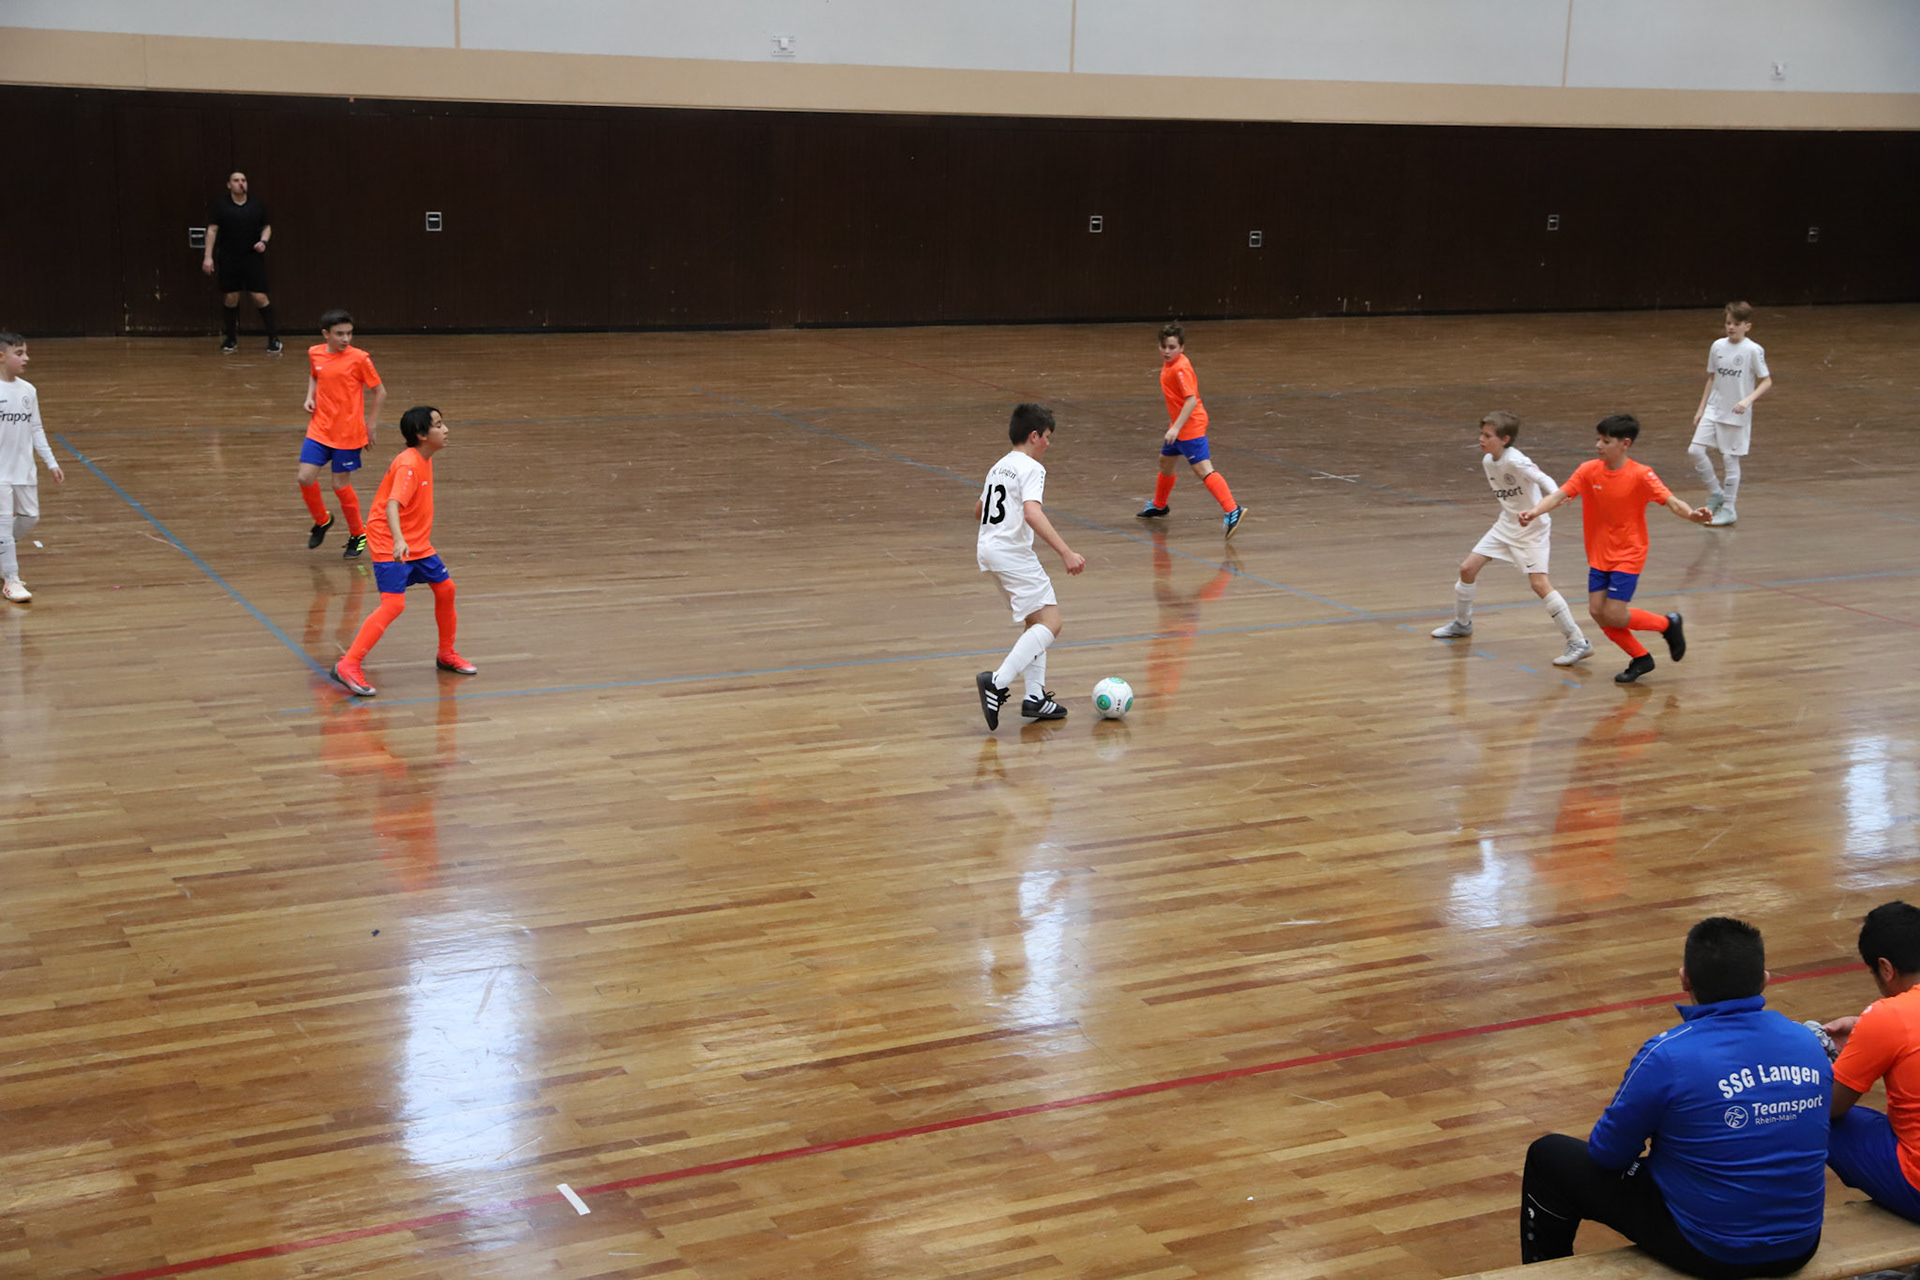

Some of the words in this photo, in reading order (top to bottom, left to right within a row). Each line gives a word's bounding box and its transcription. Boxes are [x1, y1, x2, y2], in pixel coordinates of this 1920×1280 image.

[982, 484, 1006, 525] 13
[1718, 1068, 1755, 1099] SSG
[1757, 1064, 1820, 1085] Langen
[1752, 1094, 1823, 1117] Teamsport
[1755, 1113, 1797, 1125] Rhein-Main
